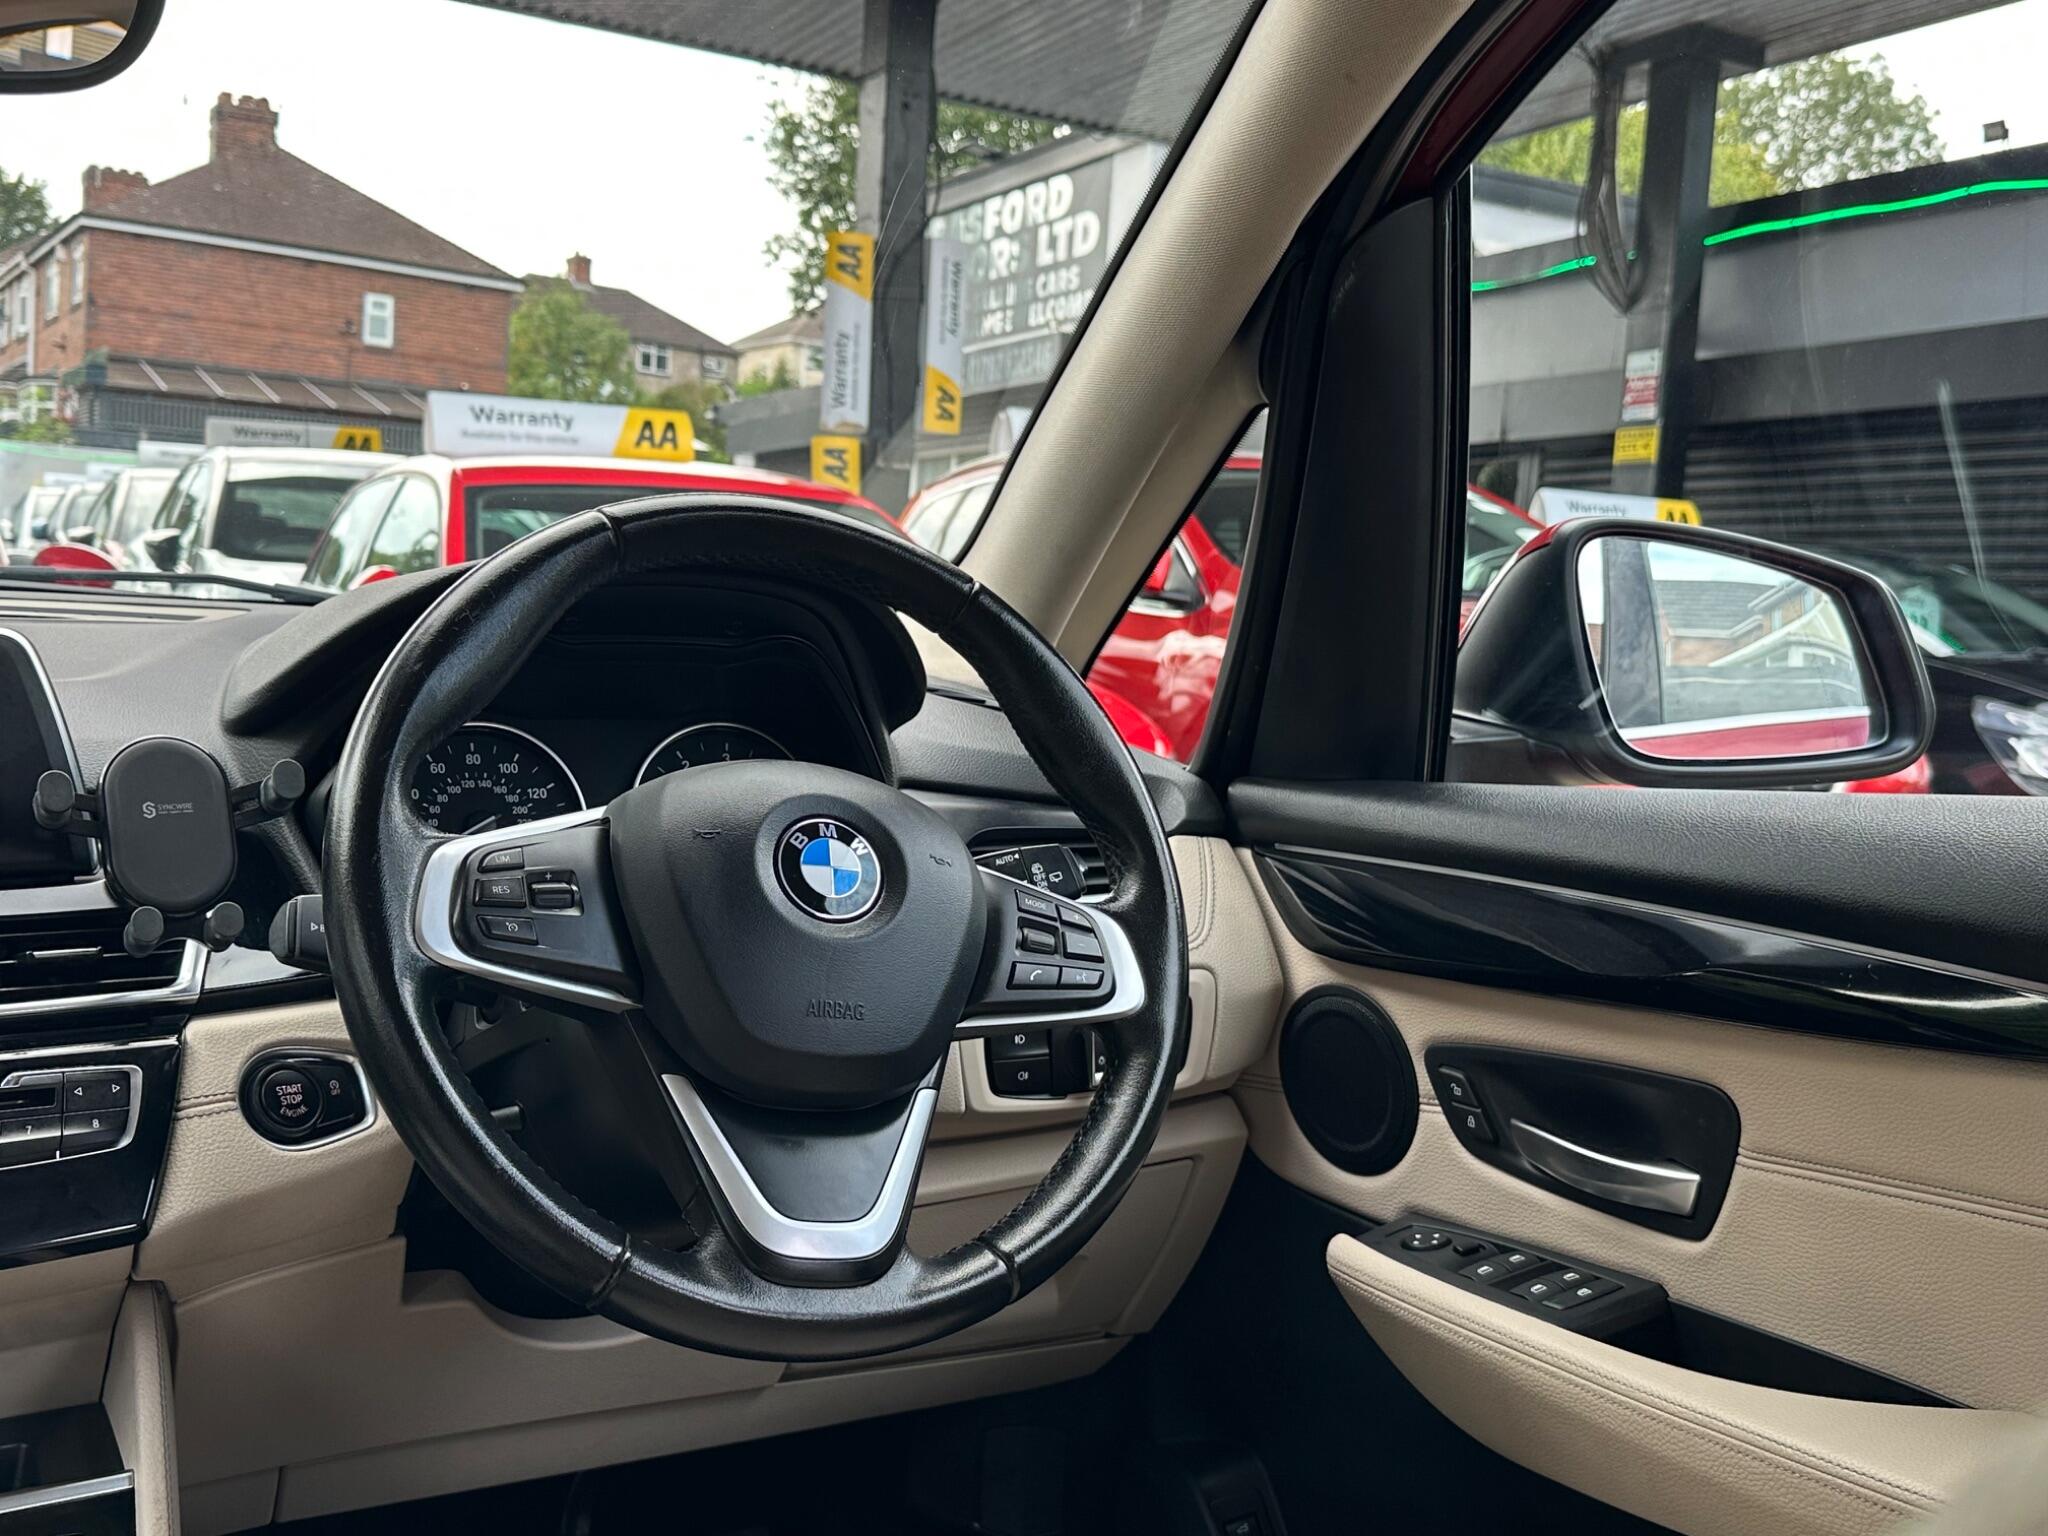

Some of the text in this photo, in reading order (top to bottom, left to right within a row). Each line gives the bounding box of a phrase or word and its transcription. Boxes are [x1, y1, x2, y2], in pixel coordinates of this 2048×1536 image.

[1035, 210, 1100, 267] LTD
[836, 243, 862, 282] AA
[947, 260, 962, 338] Warranty
[832, 329, 851, 408] Warranty
[935, 385, 955, 423] AA
[469, 404, 679, 450] Warranty AA
[823, 447, 848, 483] AA
[1566, 500, 1628, 517] Warranty
[465, 753, 481, 765] 80
[430, 763, 446, 774] 60
[498, 763, 519, 774] 100
[446, 785, 462, 794] 100
[460, 780, 475, 788] 120
[477, 780, 492, 788] 140
[493, 785, 508, 794] 160
[411, 789, 420, 800] 0
[437, 794, 449, 803] 80
[504, 794, 520, 803] 180
[527, 788, 548, 799] 120
[429, 805, 441, 814] 60
[512, 806, 528, 815] 200
[789, 823, 869, 857] BMW
[495, 855, 511, 864] LIM
[995, 854, 1015, 866] AUTO
[1033, 872, 1047, 882] OFF
[492, 885, 511, 894] RES
[1025, 898, 1048, 911] MODE
[806, 999, 865, 1021] AIRBAG
[276, 1083, 303, 1096] START
[280, 1094, 303, 1106] STOP
[280, 1104, 309, 1118] ENGINE
[92, 1118, 100, 1129] 8
[25, 1125, 33, 1136] 7
